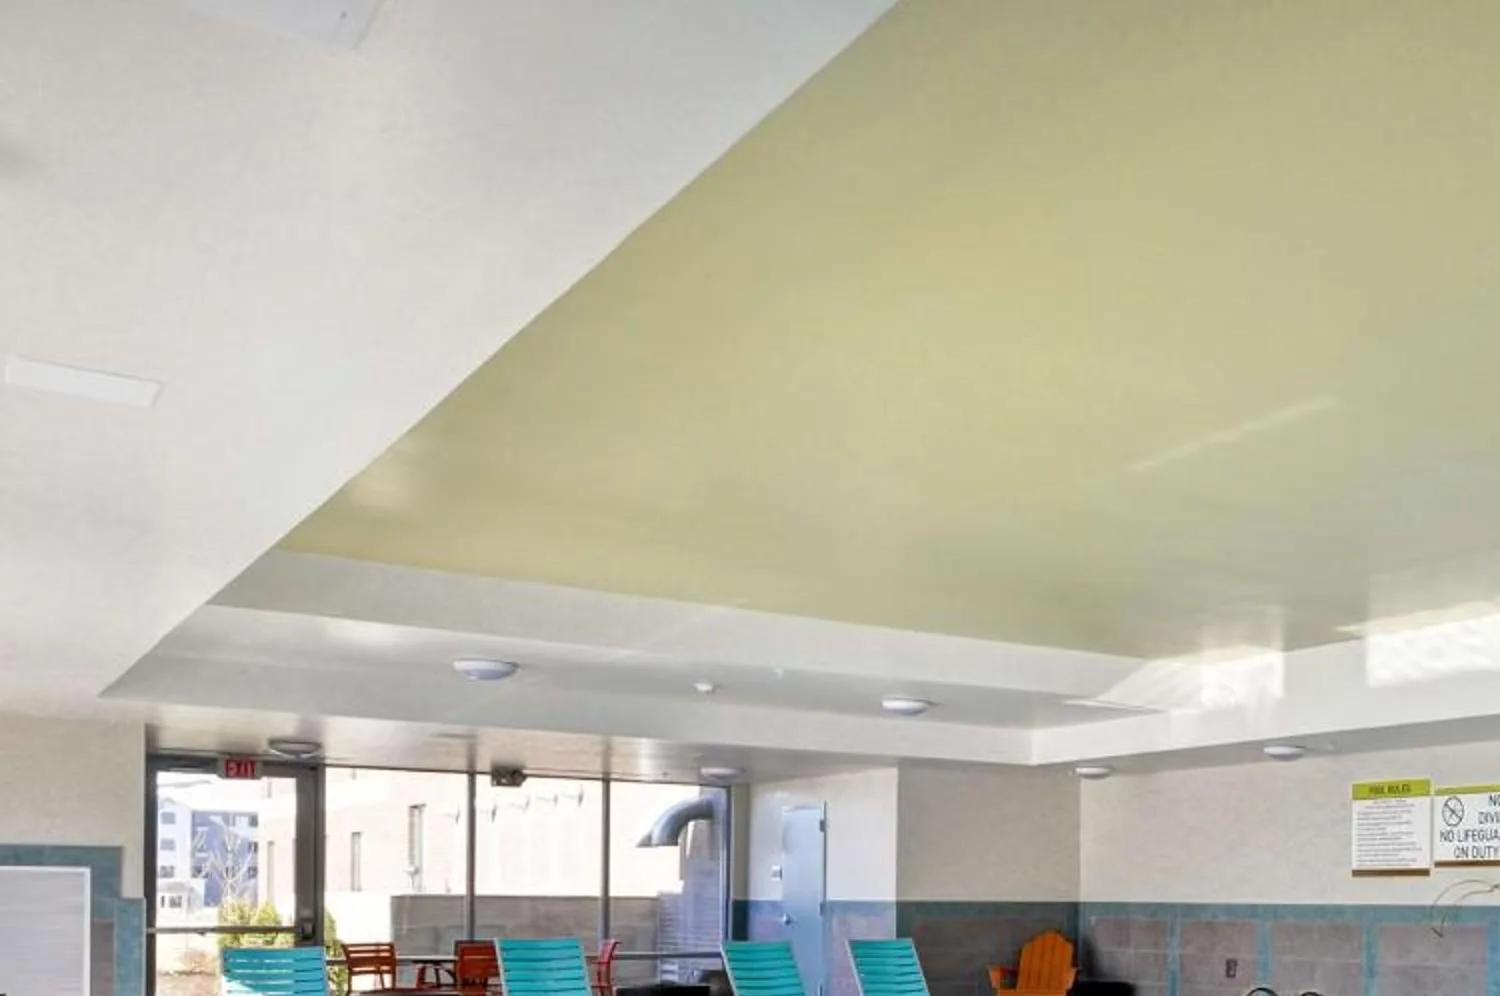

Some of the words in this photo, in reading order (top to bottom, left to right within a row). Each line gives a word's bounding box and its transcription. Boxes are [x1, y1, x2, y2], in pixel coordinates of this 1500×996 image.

[225, 759, 255, 777] EXIT
[1440, 830, 1454, 842] NO
[1454, 847, 1469, 858] ON
[1472, 846, 1499, 857] DUTY
